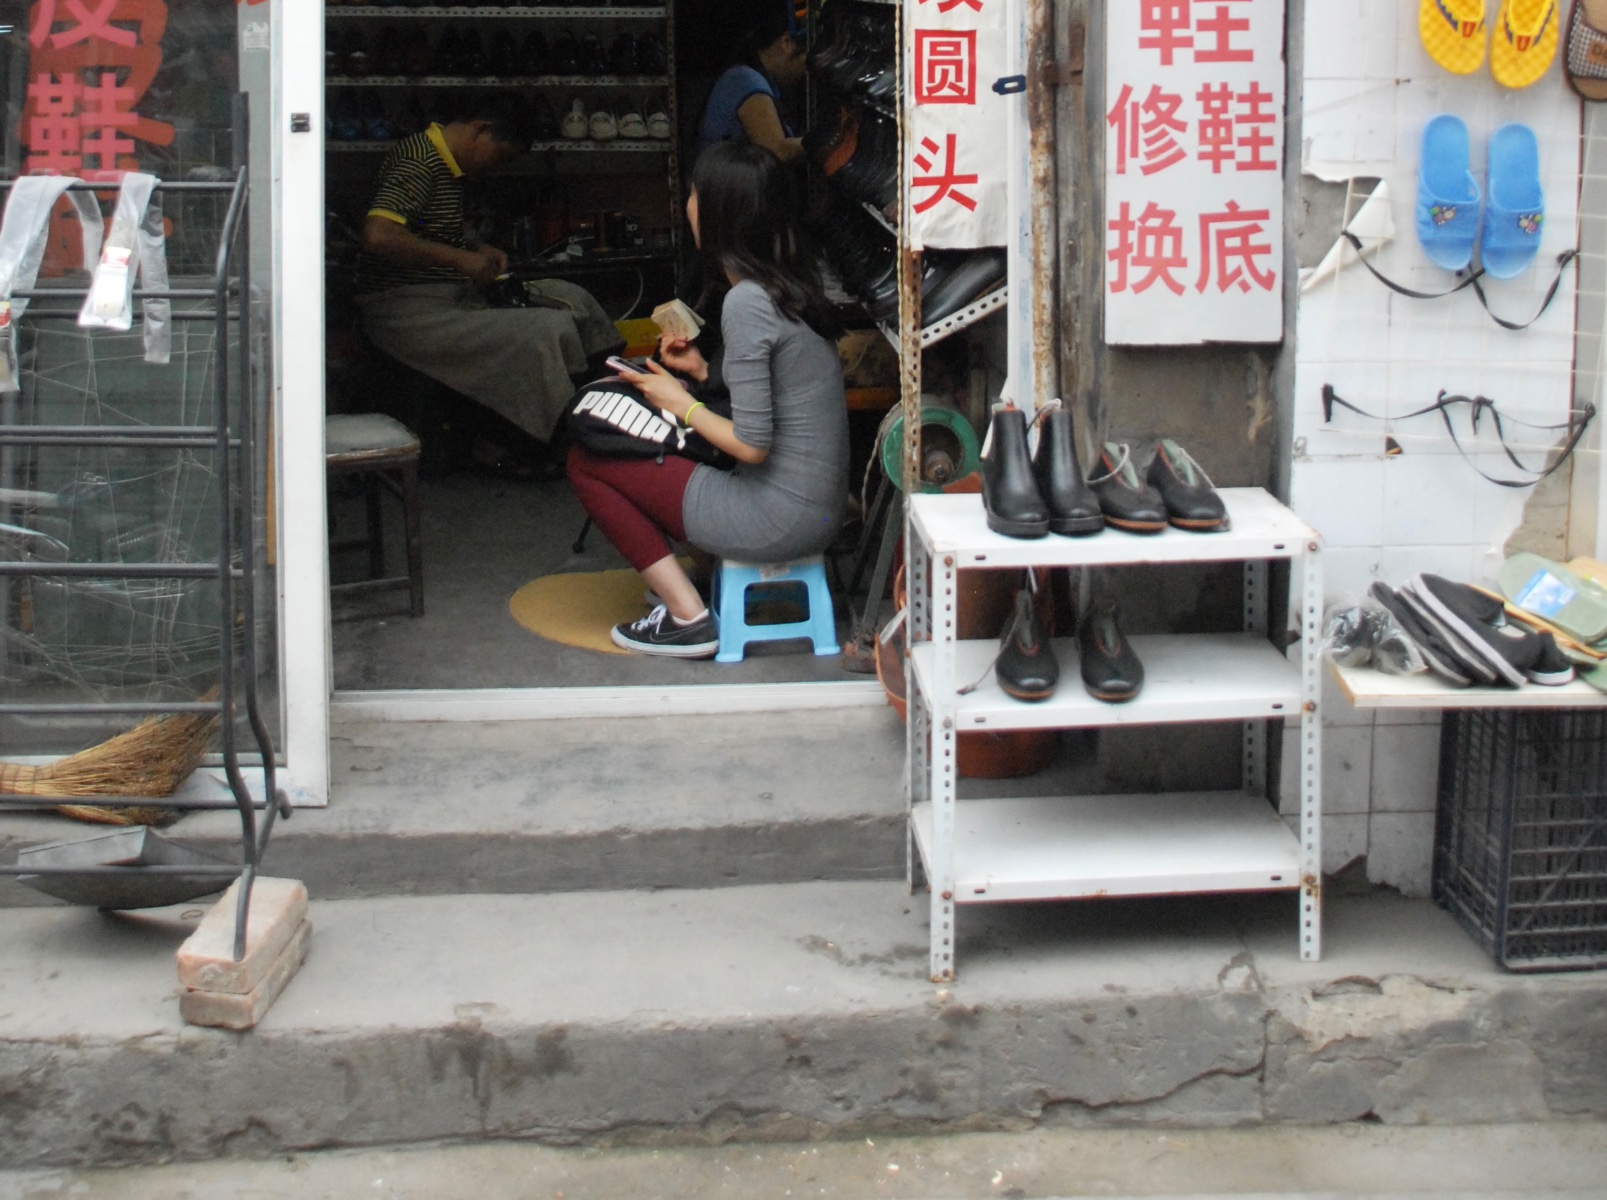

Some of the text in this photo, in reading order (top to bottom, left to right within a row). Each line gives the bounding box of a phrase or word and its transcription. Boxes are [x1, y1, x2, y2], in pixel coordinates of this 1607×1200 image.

[1106, 82, 1278, 176] 修鞋
[1107, 200, 1276, 296] 换底
[572, 391, 672, 443] PUMA
